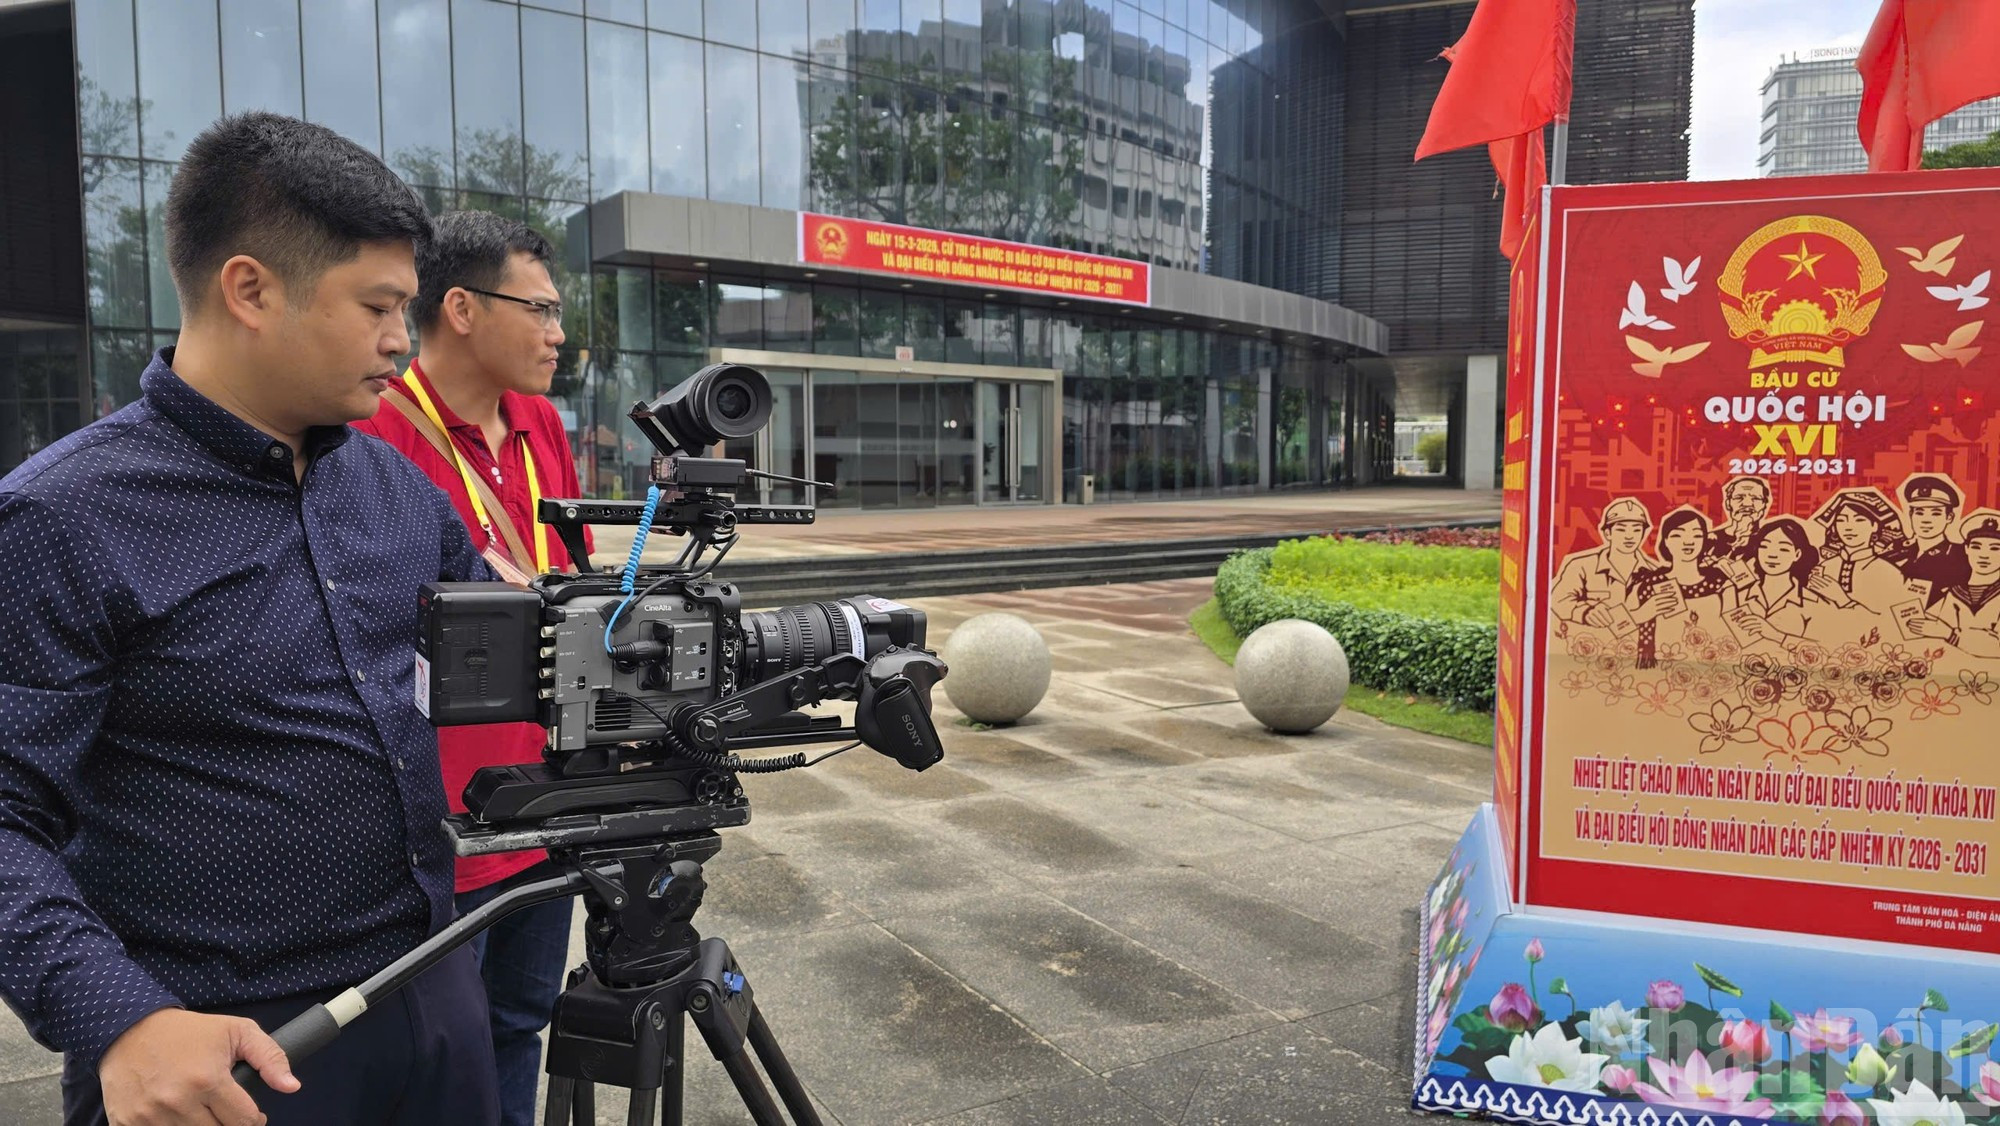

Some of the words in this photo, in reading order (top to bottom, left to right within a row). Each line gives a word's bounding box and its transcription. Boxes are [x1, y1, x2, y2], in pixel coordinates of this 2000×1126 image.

[866, 229, 892, 247] NGÀY
[942, 238, 954, 256] CỬ
[956, 243, 968, 258] TRI
[970, 242, 982, 260] CẢ
[982, 244, 1004, 263] NƯỚC
[1005, 250, 1014, 264] ĐI
[1015, 249, 1031, 267] BẦU
[1032, 252, 1042, 269] CỬ
[1043, 256, 1056, 272] ĐẠI
[1056, 254, 1073, 272] BIỂU
[1074, 258, 1092, 276] QUỐC
[882, 250, 894, 268] VÀ
[896, 256, 912, 272] ĐẠI
[914, 254, 934, 273] BIỂU
[936, 258, 950, 277] HỘI
[952, 258, 974, 277] ĐỒNG
[976, 262, 998, 280] NHÂN
[1000, 266, 1016, 282] DÂN
[1017, 268, 1032, 285] CÁC
[1034, 269, 1049, 287] CẤP
[1050, 274, 1073, 292] NHIỆM
[1074, 276, 1084, 291] KỲ
[1773, 341, 1797, 350] VIỆT
[1800, 341, 1822, 350] NAM
[1750, 367, 1798, 388] BẦU
[1806, 366, 1840, 388] CỬ
[1704, 387, 1806, 424] QUỐC
[1818, 390, 1887, 428] HỘI
[1750, 424, 1838, 456] XVI
[1728, 458, 1856, 475] 2026-2031
[902, 714, 924, 746] SONY
[1573, 754, 1608, 798] NHIỆT
[1611, 756, 1636, 799] LIỆT
[1640, 758, 1672, 796] CHÀO
[1676, 762, 1714, 799] MỪNG
[1717, 765, 1750, 801] NGÀY
[1754, 761, 1780, 803] BẦU
[1784, 763, 1804, 804] CỬ
[1805, 775, 1828, 817] ĐẠI
[1831, 766, 1862, 810] BIỂU
[1865, 769, 1902, 813] QUỐC
[1905, 774, 1928, 825] HỘI
[1932, 778, 1968, 820] KHÓA
[1971, 786, 1996, 822] XVI
[1575, 804, 1592, 840] VÀ
[1594, 810, 1614, 849] ĐẠI
[1618, 802, 1646, 846] BIỂU
[1648, 810, 1669, 856] HỘI
[1672, 808, 1706, 850] ĐỒNG
[1710, 816, 1747, 854] NHÂN
[1750, 817, 1777, 857] DÂN
[1780, 820, 1807, 860] CÁC
[1810, 820, 1837, 862] CẤP
[1839, 826, 1884, 874] NHIỆM
[1886, 828, 1906, 868] KỲ
[1907, 839, 1942, 872] 2026
[1954, 842, 1987, 876] 2031
[1872, 901, 1900, 912] TRUNG
[1902, 903, 1920, 914] TÂM
[1922, 904, 1940, 916] VĂN
[1966, 910, 1987, 922] ĐIỆN
[1896, 916, 1924, 927] THÀNH
[1925, 916, 1942, 928] PHỐ
[1944, 919, 1956, 930] ĐÀ
[1958, 920, 1982, 932] NẴNG
